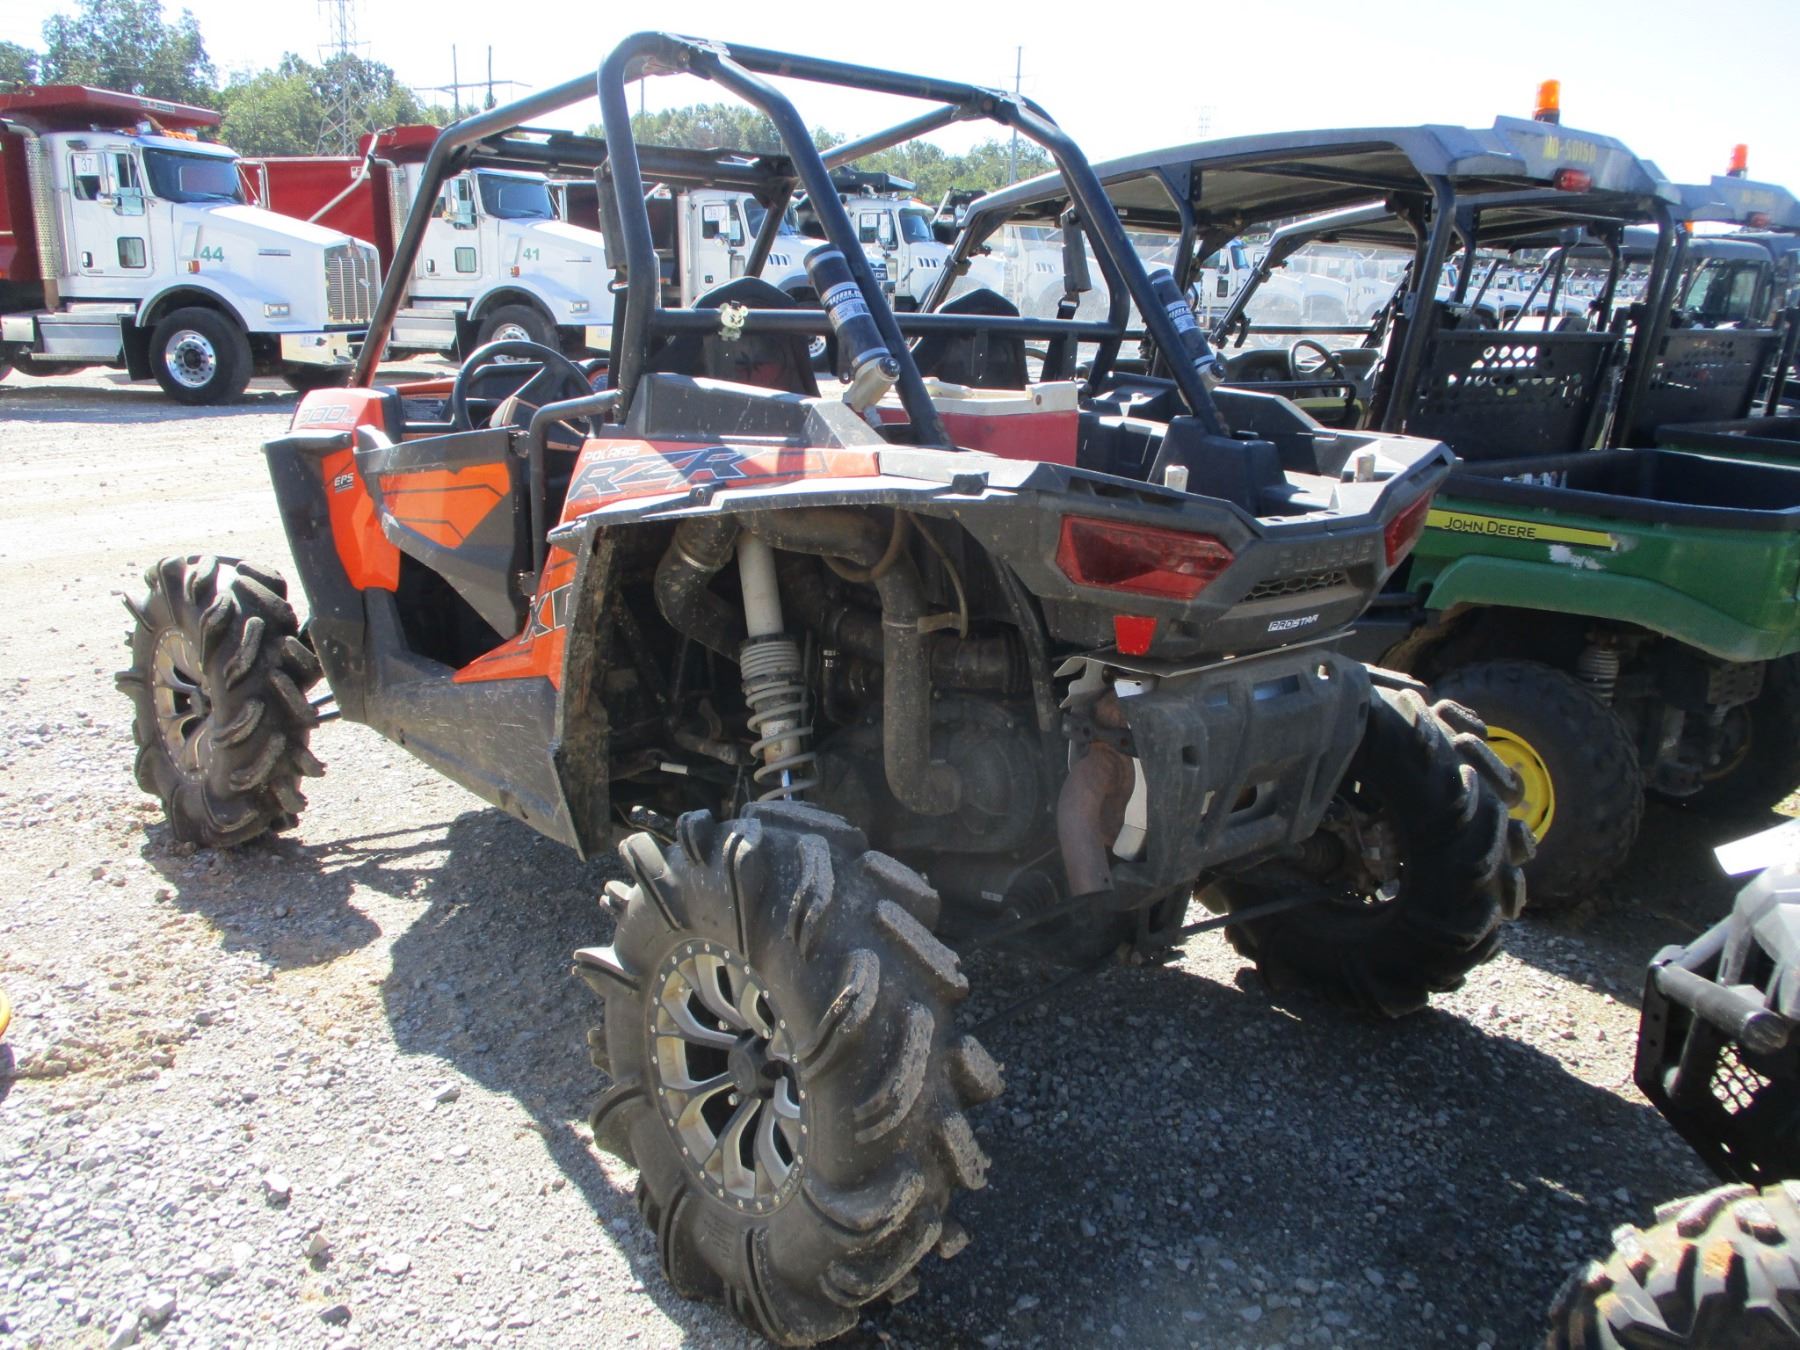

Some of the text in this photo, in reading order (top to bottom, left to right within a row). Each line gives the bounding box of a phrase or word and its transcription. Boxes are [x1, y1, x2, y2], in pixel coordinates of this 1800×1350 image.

[200, 246, 224, 262] 44
[523, 248, 540, 261] 41
[582, 444, 641, 462] POLARIS
[334, 472, 354, 486] EPS
[567, 446, 777, 502] RZR
[1443, 516, 1537, 541] JOHN DEERE
[1267, 613, 1320, 632] PROSTAR
